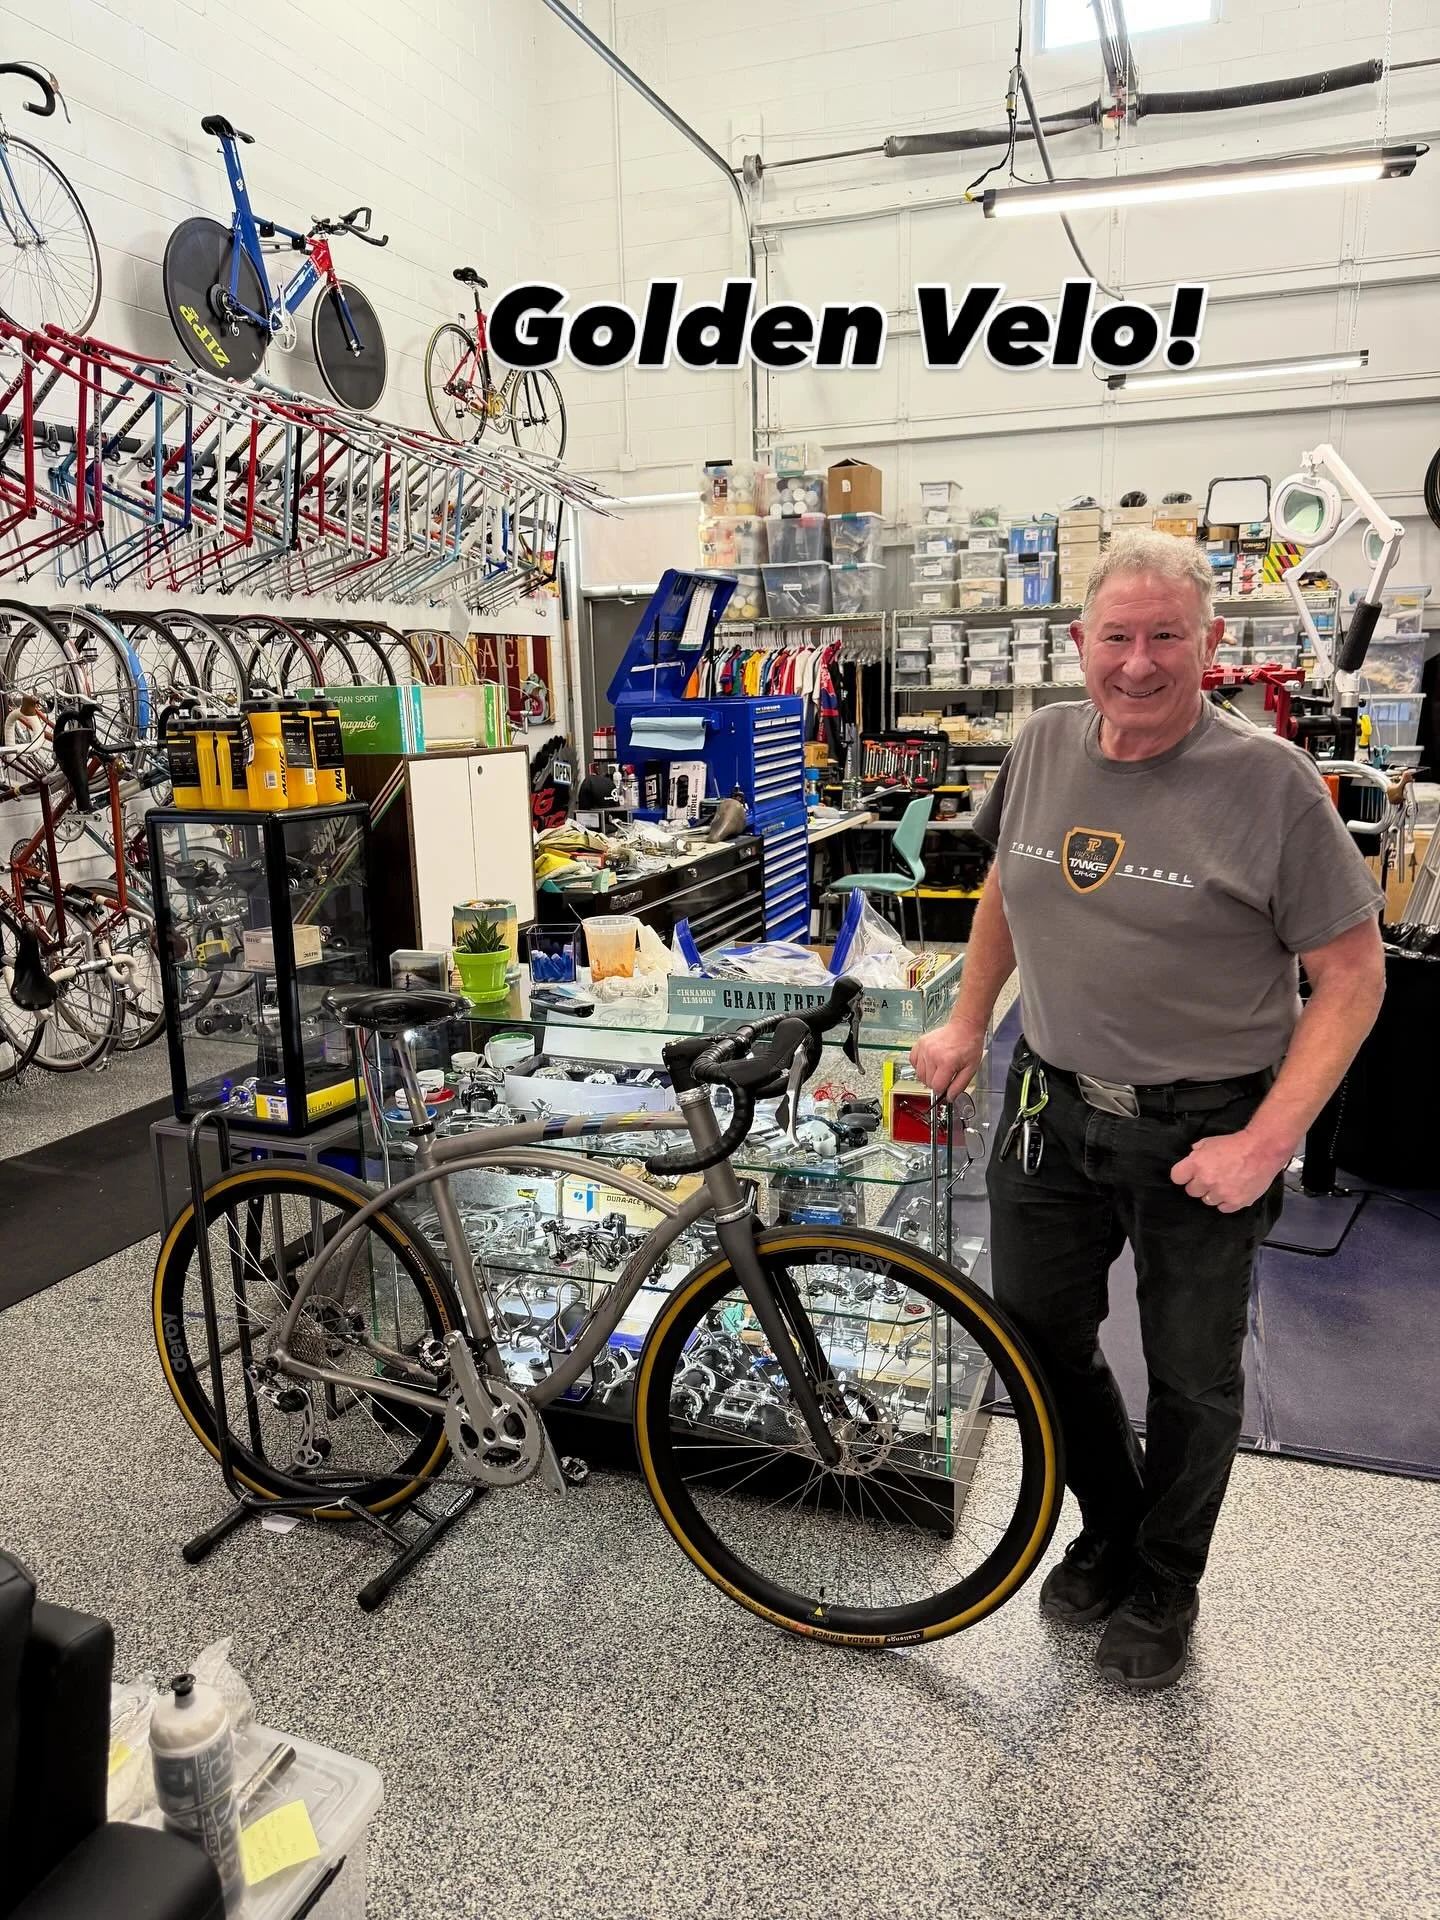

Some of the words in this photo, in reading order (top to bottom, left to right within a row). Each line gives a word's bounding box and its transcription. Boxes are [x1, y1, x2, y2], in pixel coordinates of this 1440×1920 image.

[179, 305, 231, 369] ZIPP
[333, 695, 355, 704] GRAN
[355, 694, 378, 703] SPORT
[279, 750, 288, 797] MAVIC
[1012, 842, 1055, 858] TANGE
[1069, 858, 1108, 873] TANGE
[1124, 865, 1192, 883] STEEL
[677, 989, 716, 997] CINNAMON
[682, 996, 713, 1004] ALMOND
[723, 989, 776, 1011] GRAIN
[900, 1000, 913, 1010] 16
[606, 1195, 641, 1206] DURA-ACE
[815, 1249, 893, 1276] derby
[162, 1312, 188, 1373] derby
[812, 1628, 844, 1641] BIANCA
[846, 1636, 880, 1645] STRADA
